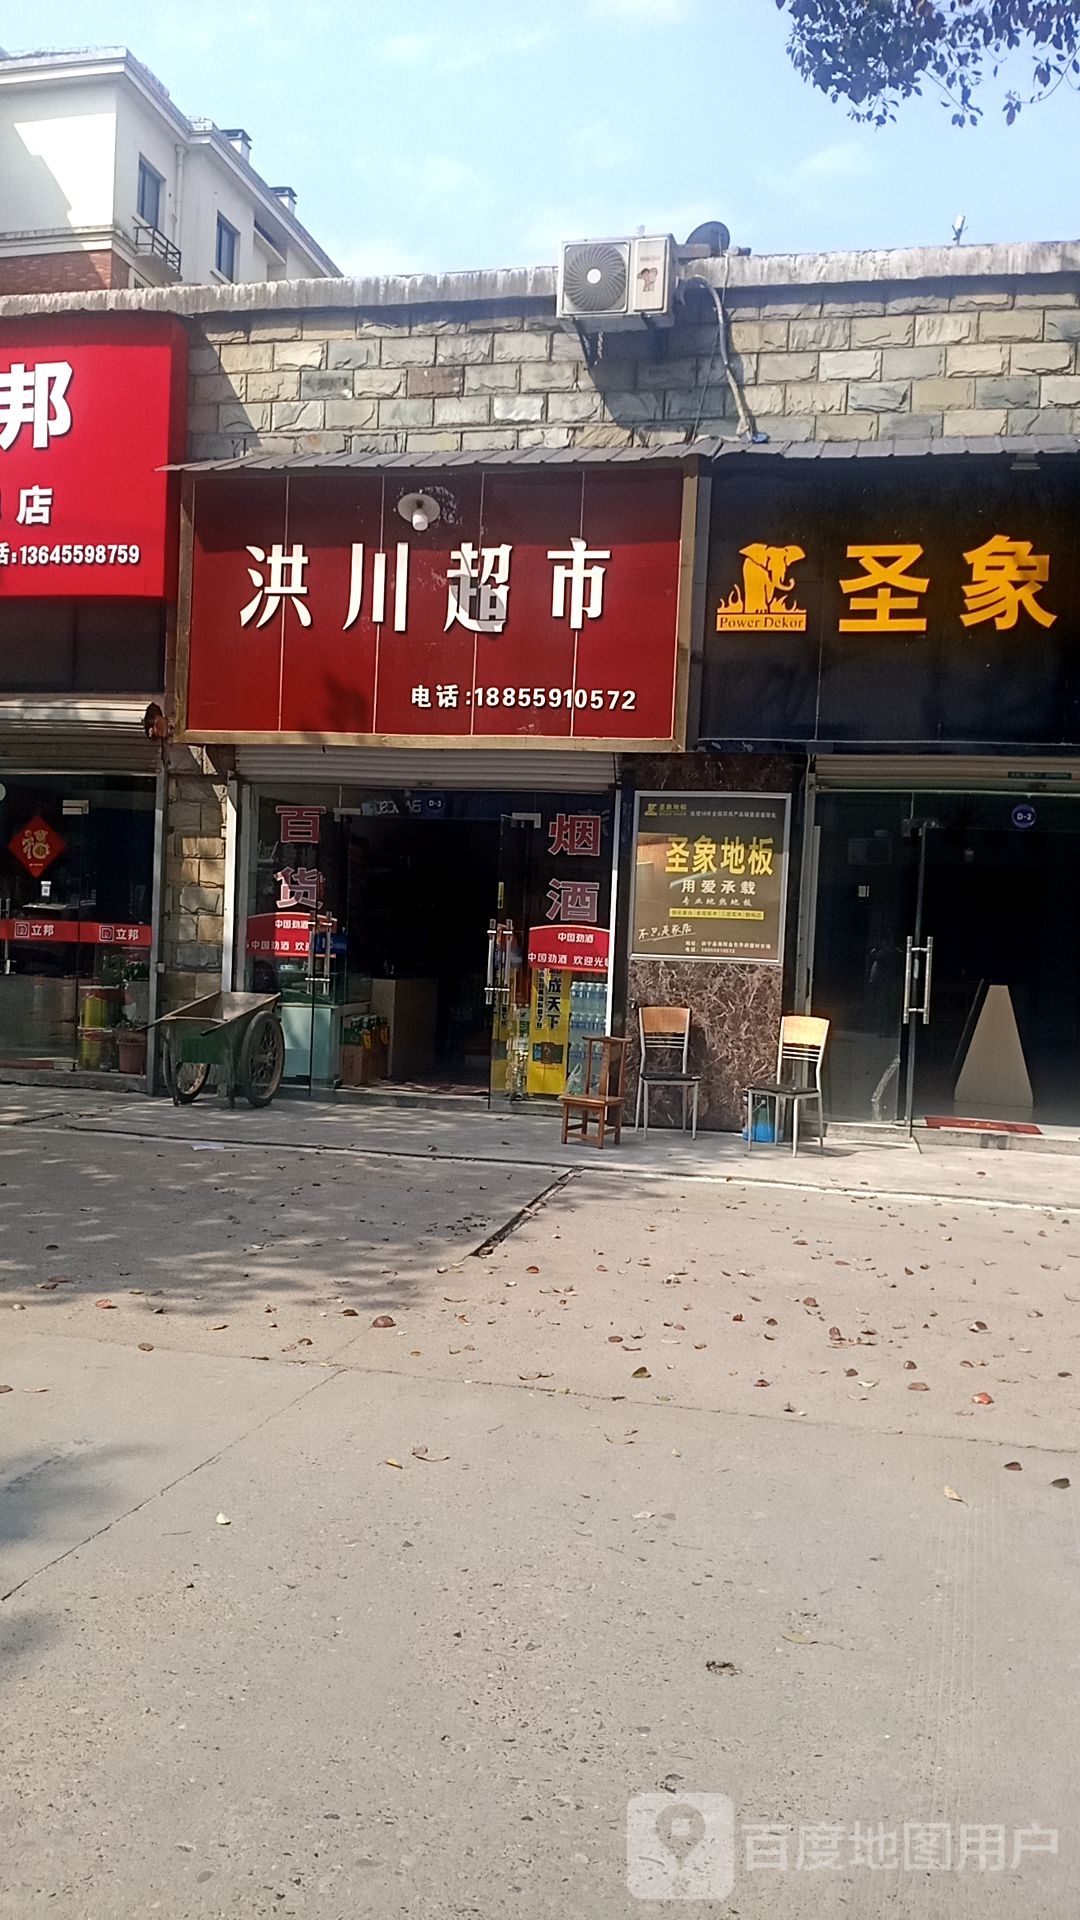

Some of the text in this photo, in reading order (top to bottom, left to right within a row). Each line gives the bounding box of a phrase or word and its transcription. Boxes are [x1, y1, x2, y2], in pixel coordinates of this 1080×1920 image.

[16, 485, 53, 525] 店
[240, 538, 611, 634] 洪川超市
[838, 534, 1057, 633] 圣象
[720, 617, 804, 628] Power Dekor
[411, 684, 637, 710] 电话:18855910572
[1017, 813, 1032, 821] D-2
[274, 805, 326, 909] 百货
[665, 835, 774, 876] 圣象地板
[545, 813, 601, 923] 烟酒
[681, 879, 756, 895] 用爱承载
[31, 924, 54, 936] 立邦
[275, 919, 308, 929] 中国劲酒
[116, 928, 139, 940] 立邦
[557, 932, 594, 944] 中国劲酒
[251, 940, 290, 951] 中国劲酒
[528, 952, 568, 965] 中国劲酒
